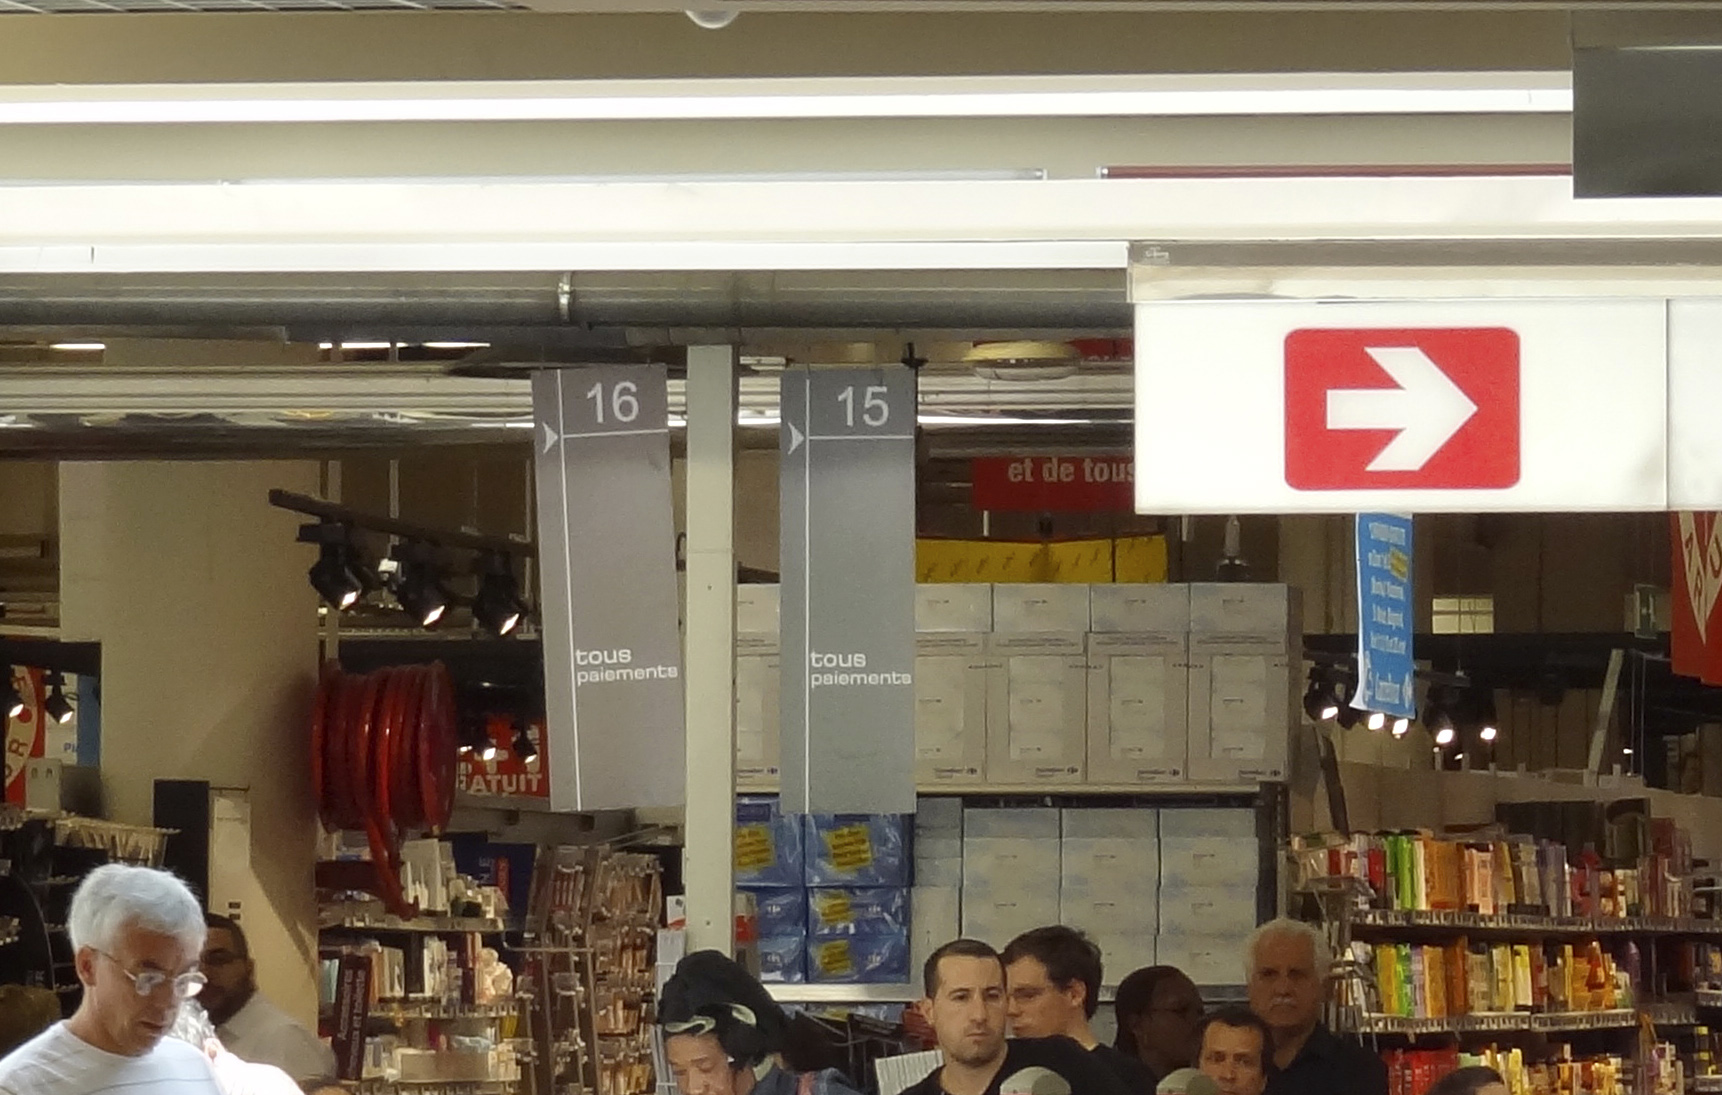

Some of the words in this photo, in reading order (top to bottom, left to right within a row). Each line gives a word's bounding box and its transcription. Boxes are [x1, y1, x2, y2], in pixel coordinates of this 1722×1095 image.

[586, 380, 639, 423] 16
[837, 386, 890, 427] 15
[1008, 458, 1034, 482] et
[1042, 458, 1075, 482] de
[575, 648, 632, 665] tous
[810, 649, 867, 668] tous
[577, 664, 679, 687] paiements
[811, 671, 913, 689] paiements
[337, 969, 354, 1041] Accessoires
